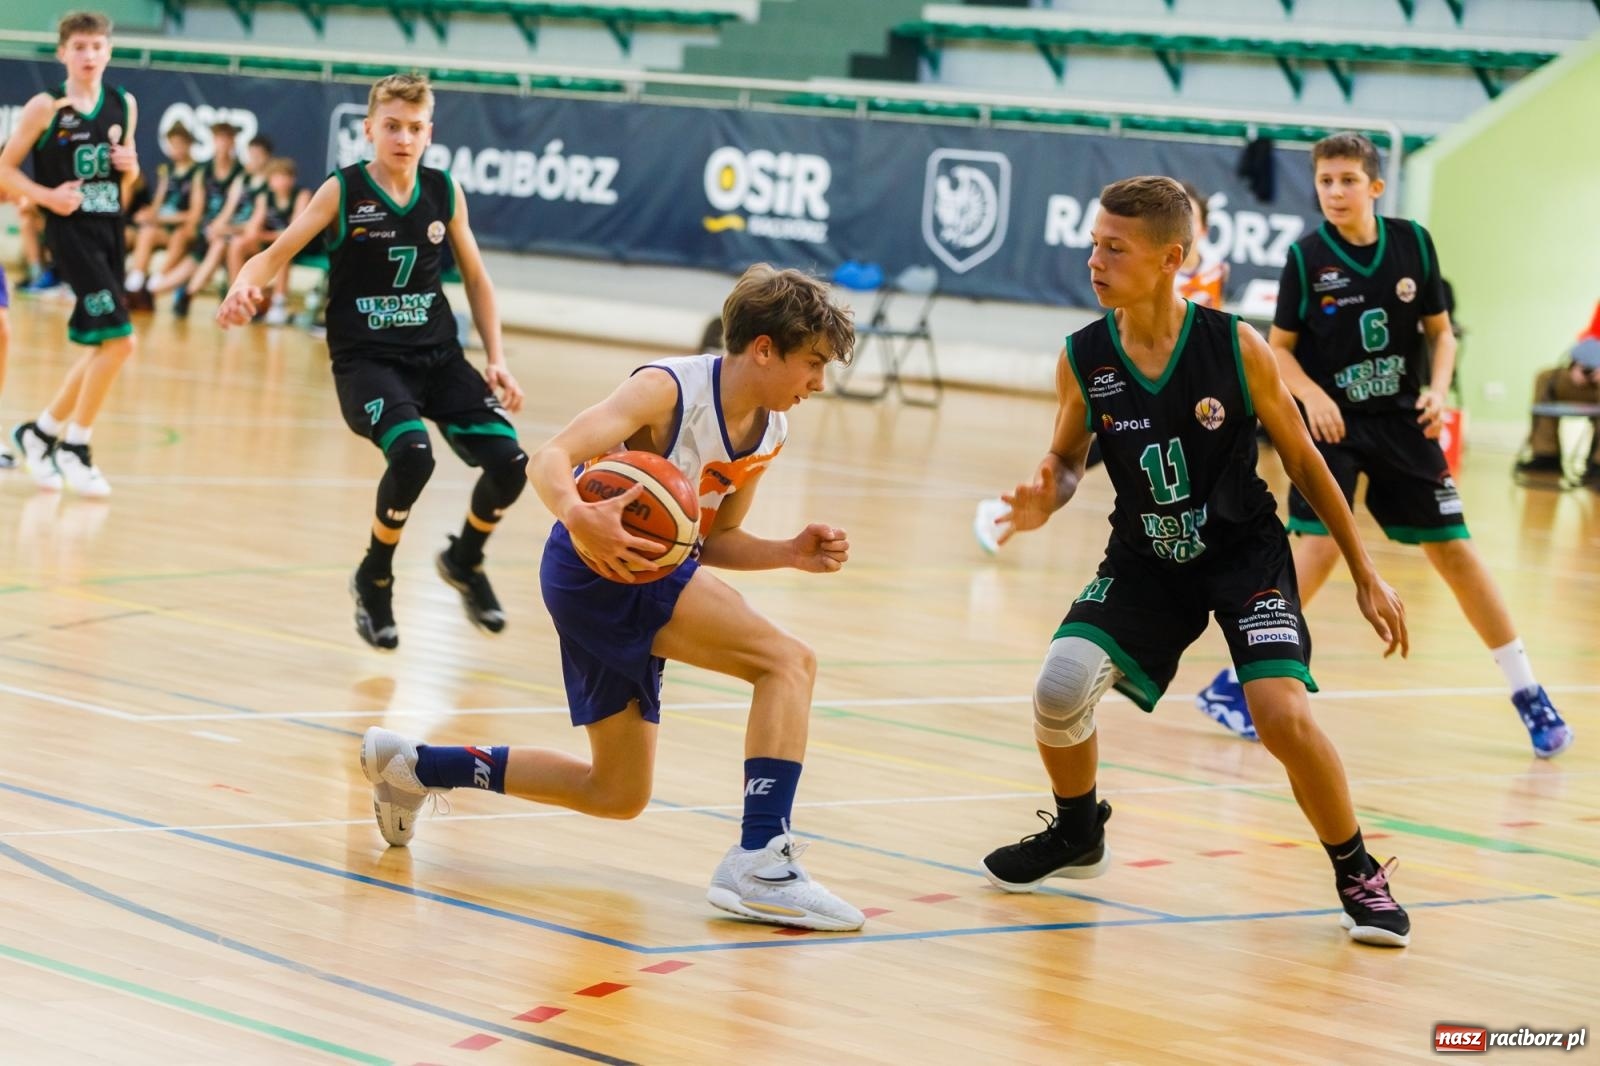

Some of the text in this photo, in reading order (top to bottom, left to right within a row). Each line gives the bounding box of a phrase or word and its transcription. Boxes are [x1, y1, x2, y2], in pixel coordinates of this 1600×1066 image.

[158, 102, 258, 165] OSR
[388, 246, 418, 288] 7
[1359, 307, 1389, 353] 6
[1093, 372, 1115, 386] PGE
[364, 397, 384, 425] 7
[1114, 418, 1151, 431] OPOLE
[1139, 437, 1190, 505] 11
[585, 479, 652, 521] moen
[1254, 598, 1286, 612] PGE
